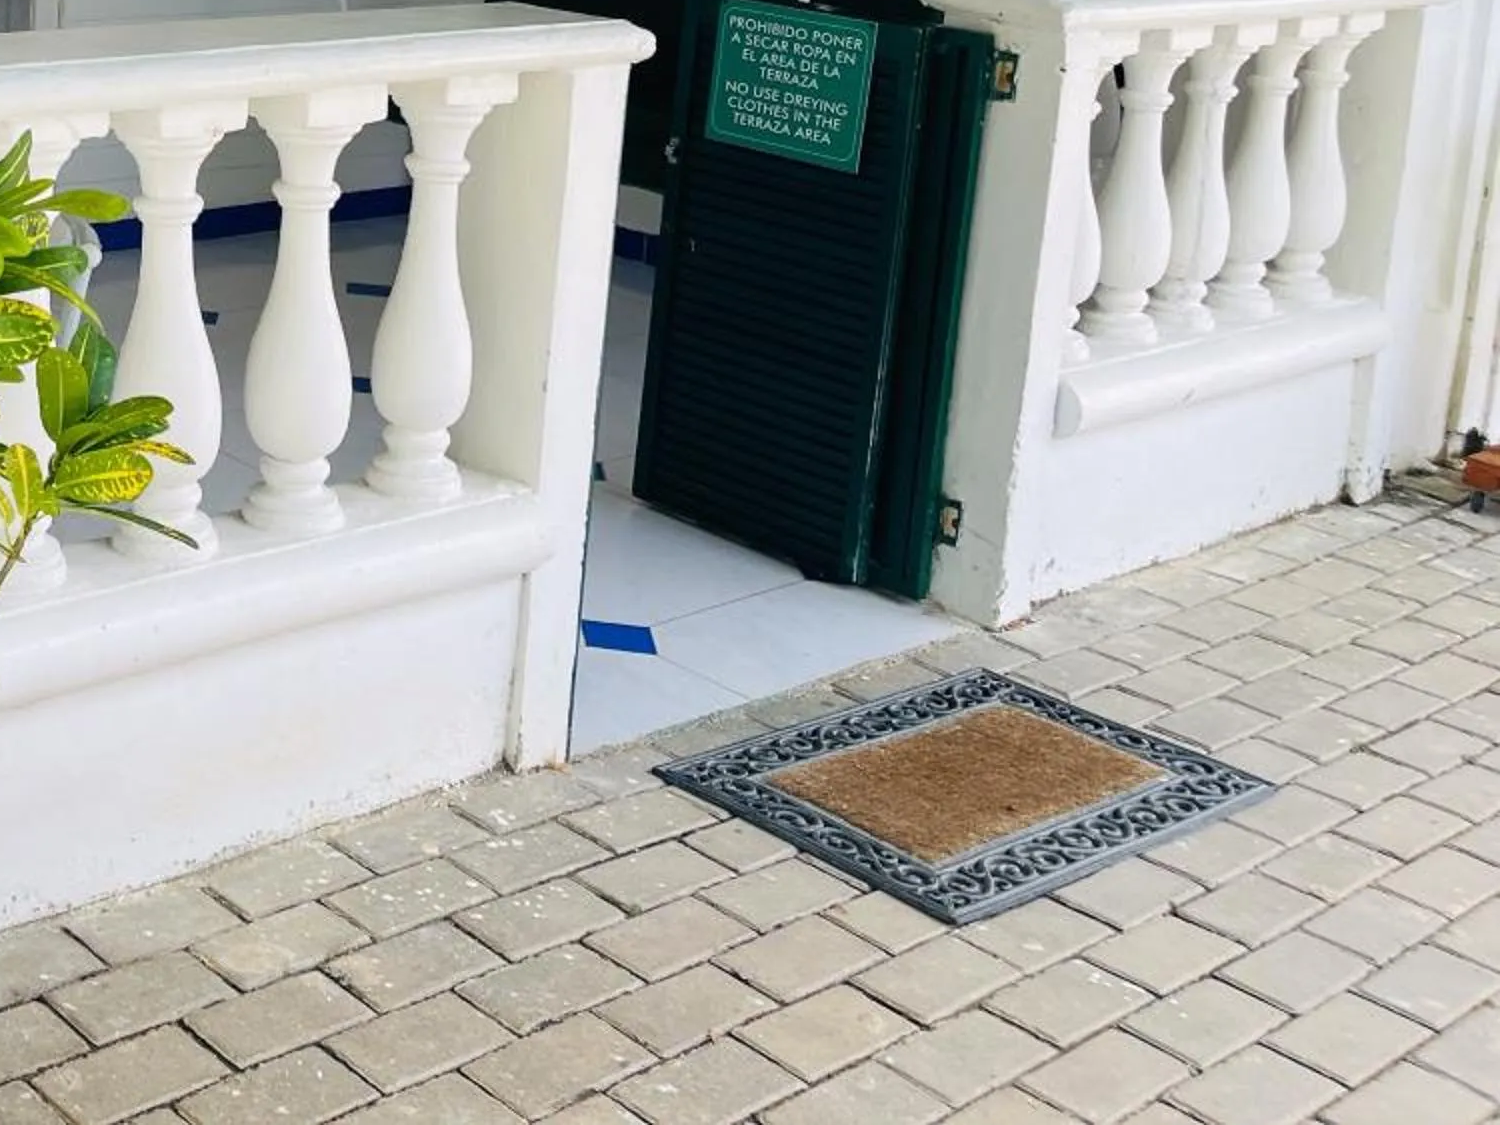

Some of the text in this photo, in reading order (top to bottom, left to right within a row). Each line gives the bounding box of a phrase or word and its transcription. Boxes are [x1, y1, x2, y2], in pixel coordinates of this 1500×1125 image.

[729, 15, 863, 52] PROHIBIDO PONER
[731, 32, 857, 66] A SECAR ROPA EN
[742, 49, 841, 80] EL AREA DE LA
[760, 67, 819, 91] TERRAZA
[725, 81, 849, 116] NO USE DREYING
[727, 96, 842, 132] CLOTHES IN THE
[732, 111, 832, 145] TERRAZA AREA
